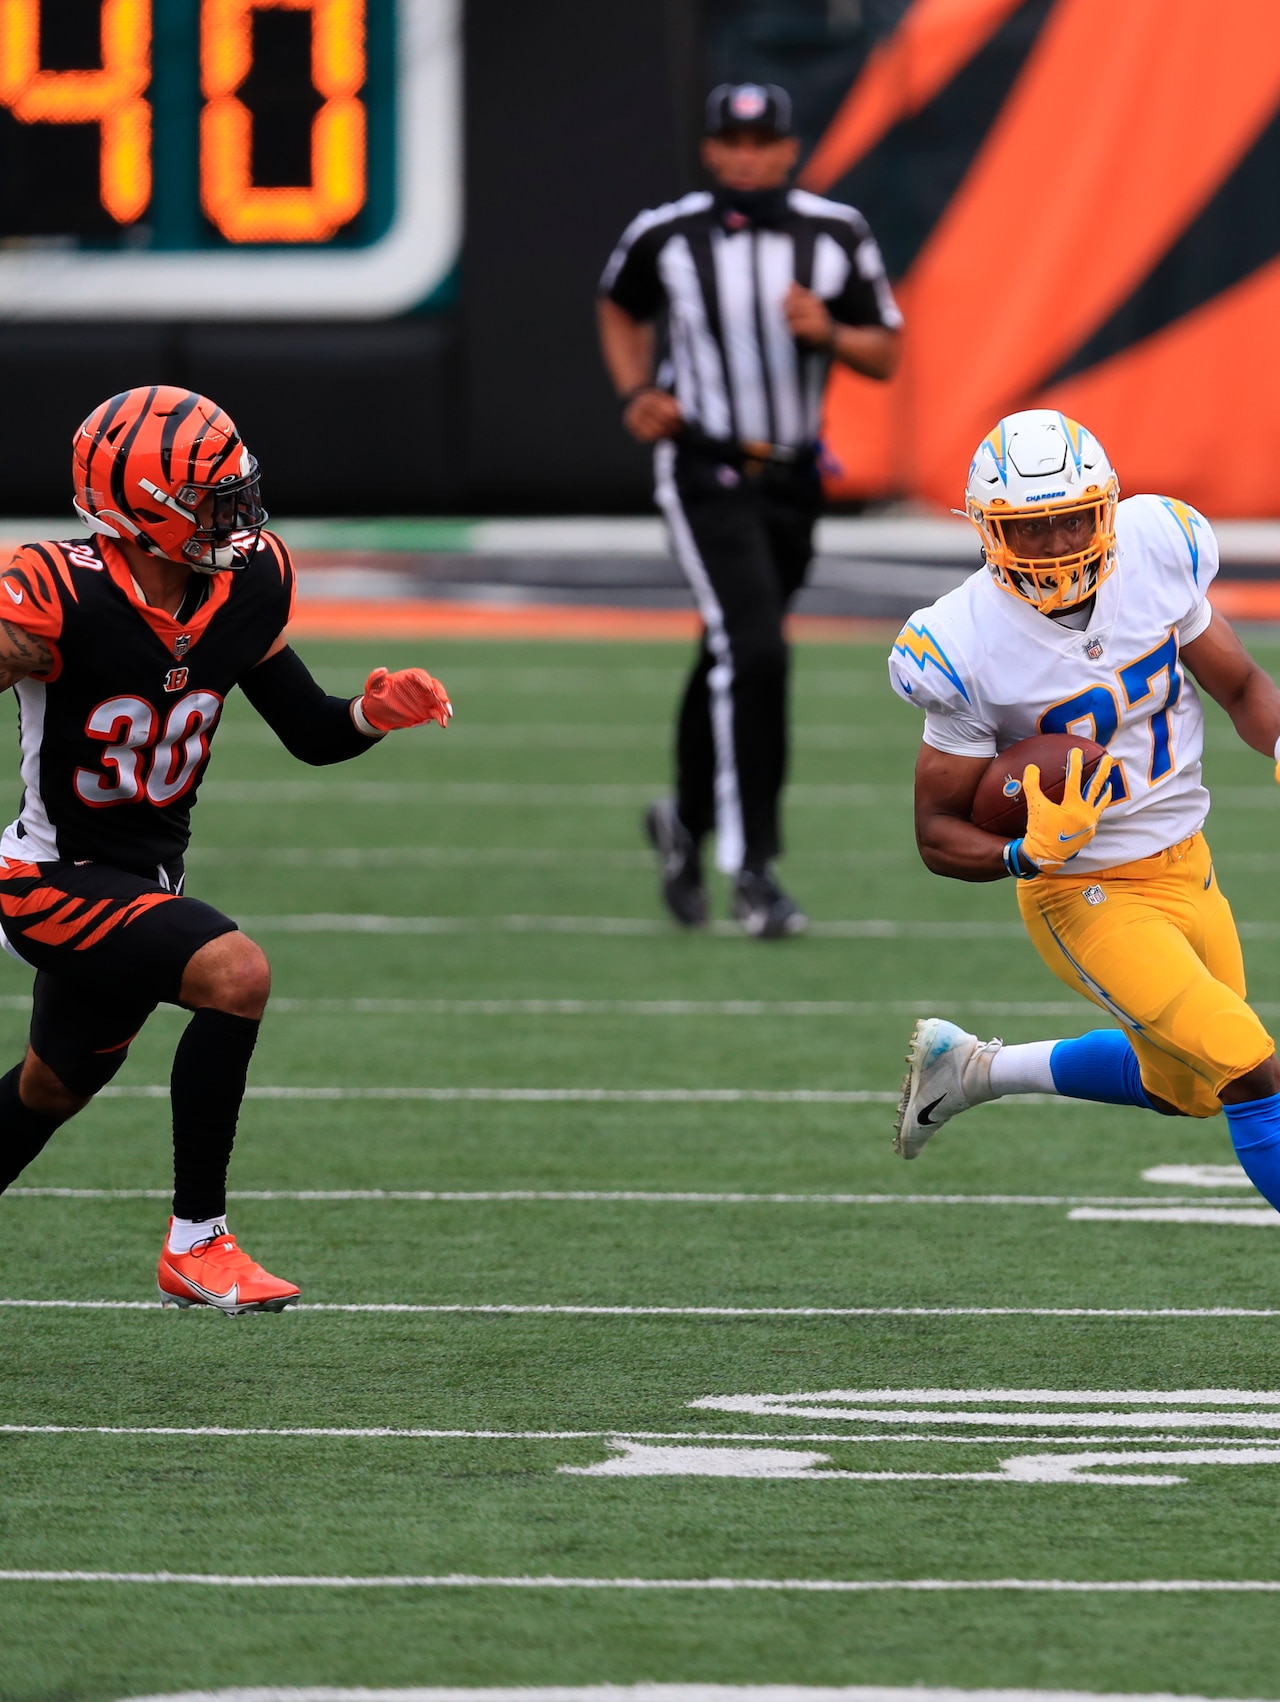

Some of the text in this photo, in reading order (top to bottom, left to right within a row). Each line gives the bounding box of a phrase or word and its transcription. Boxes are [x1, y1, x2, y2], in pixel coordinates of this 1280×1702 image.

[0, 0, 367, 243] 40
[73, 689, 223, 808] 30
[1036, 625, 1183, 807] 27
